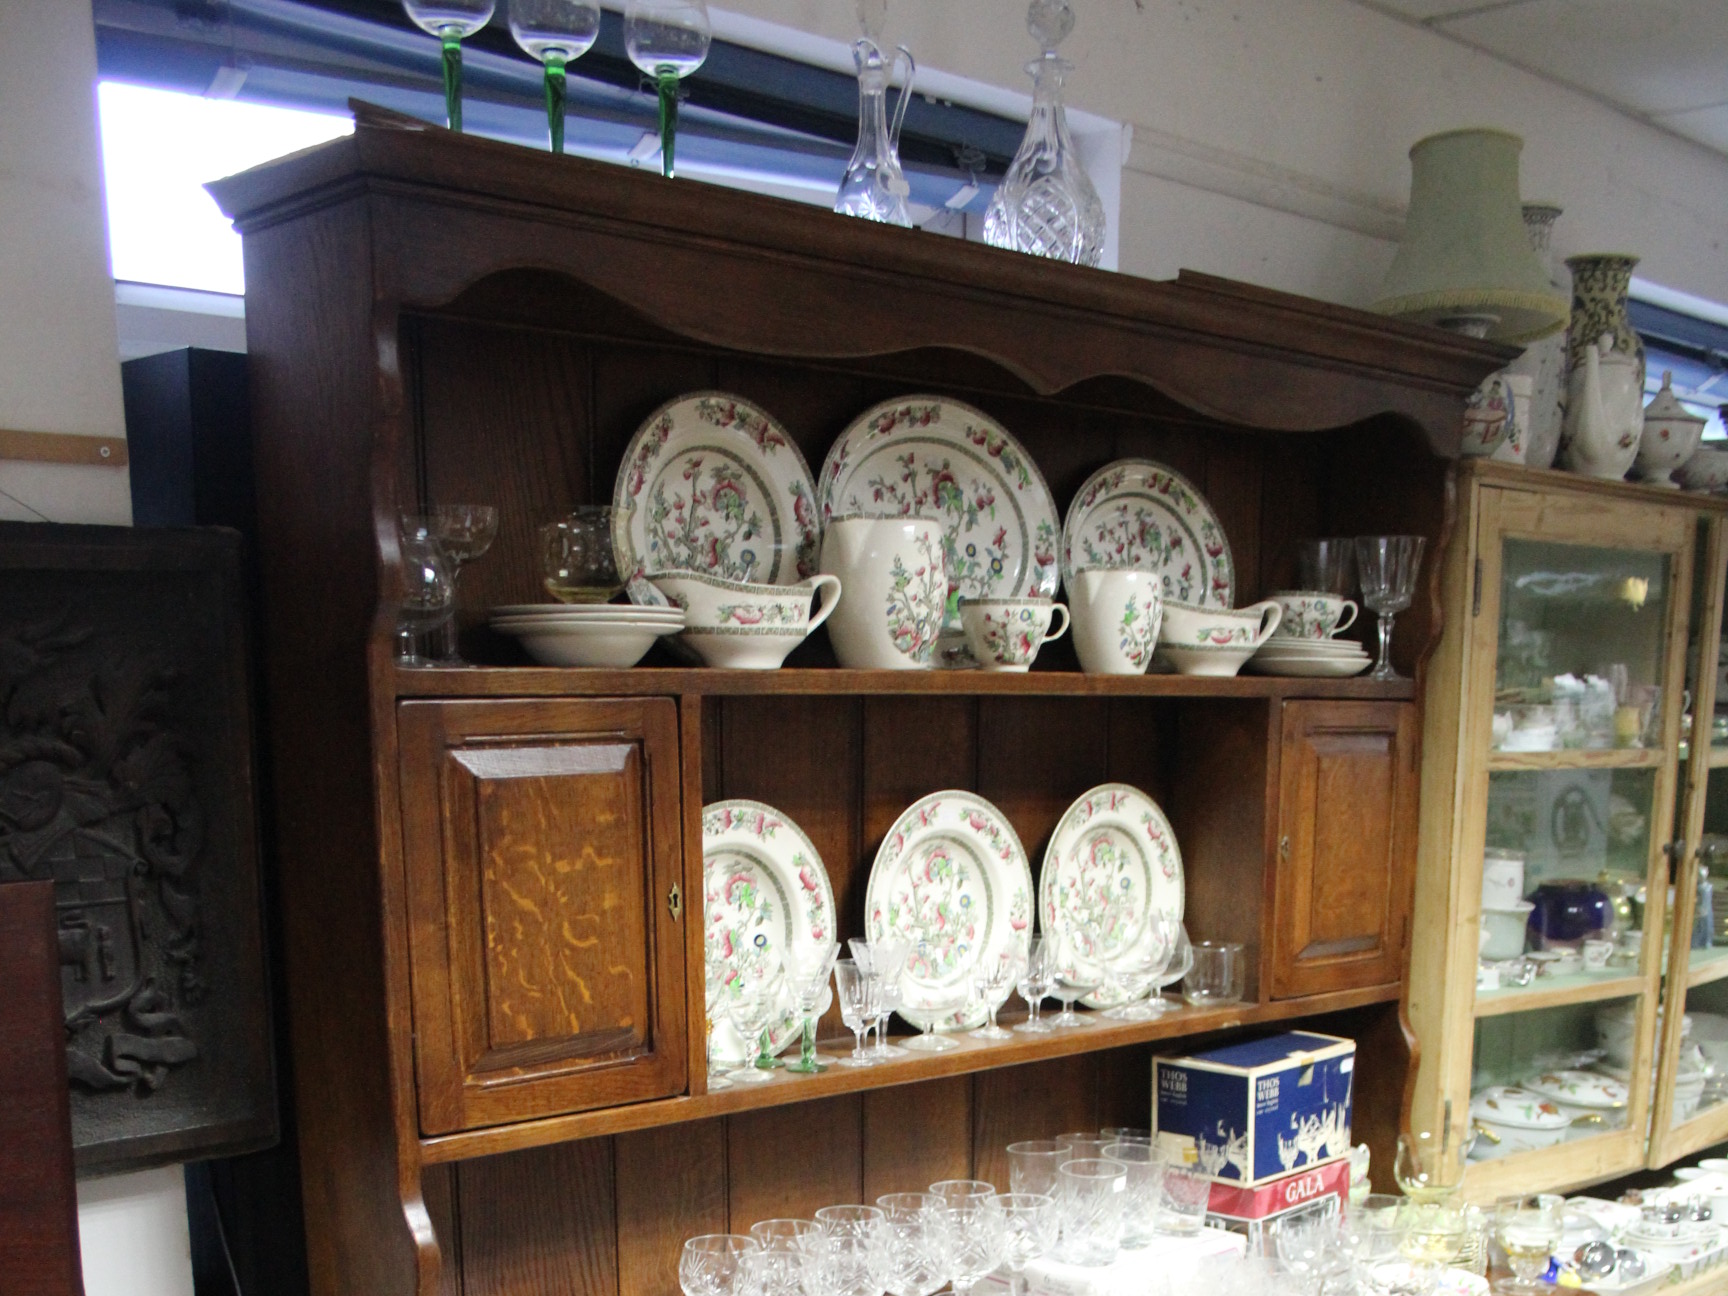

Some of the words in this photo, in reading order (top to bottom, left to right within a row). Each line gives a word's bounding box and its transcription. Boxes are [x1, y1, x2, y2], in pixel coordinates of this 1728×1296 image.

[1160, 1069, 1188, 1081] THOS
[1161, 1080, 1188, 1092] WEBB
[1257, 1077, 1280, 1091] THOS
[1257, 1087, 1280, 1101] WEBB
[1285, 1172, 1325, 1203] GALA
